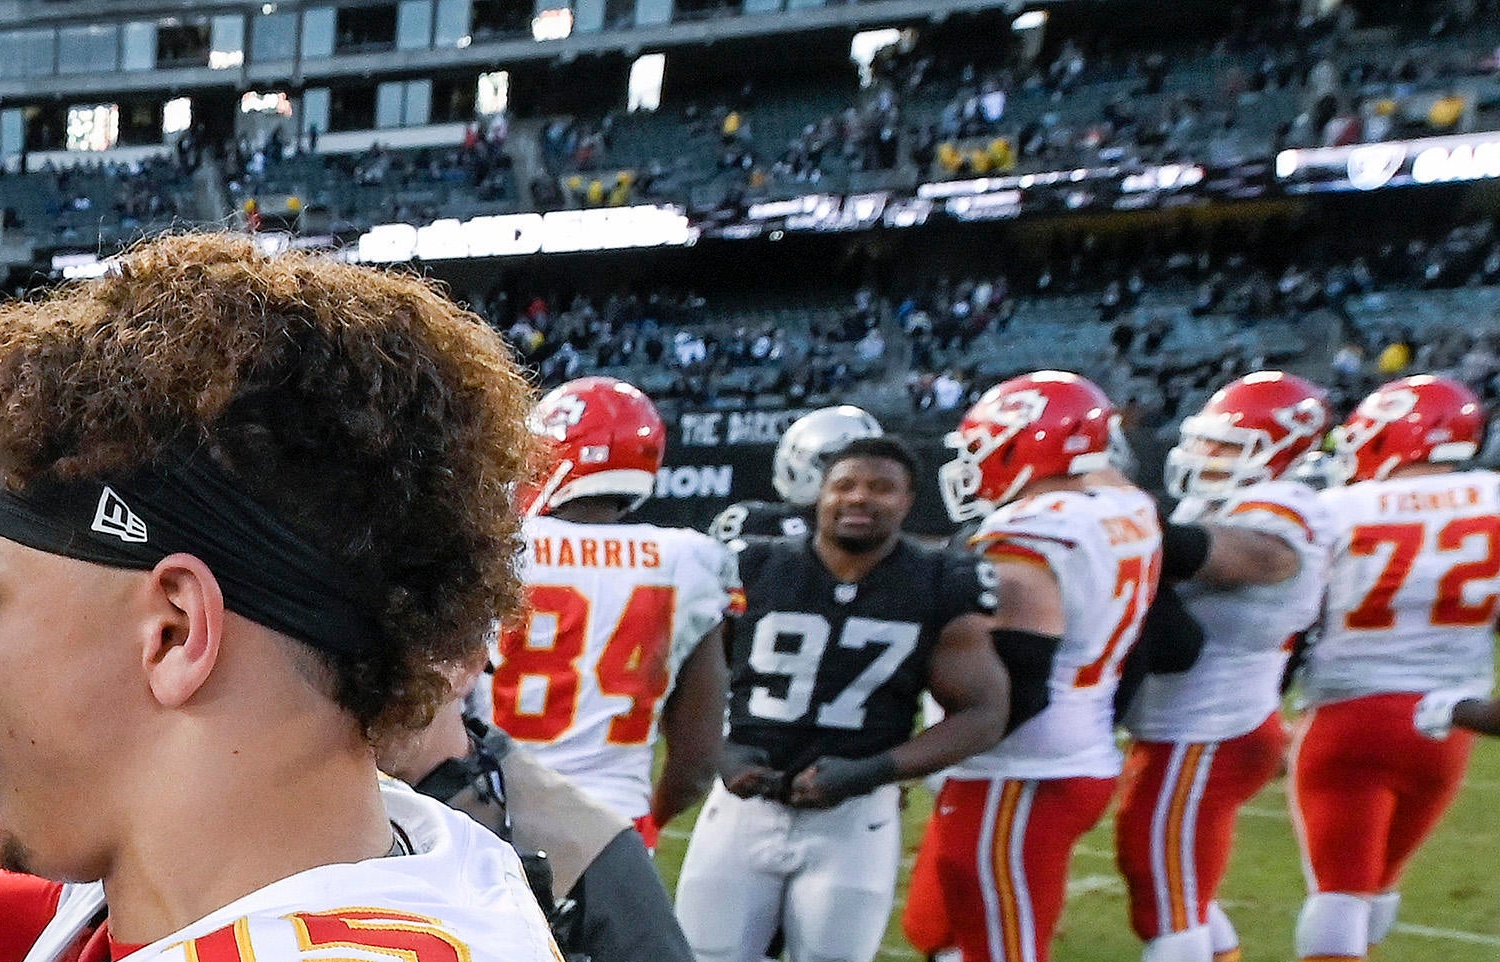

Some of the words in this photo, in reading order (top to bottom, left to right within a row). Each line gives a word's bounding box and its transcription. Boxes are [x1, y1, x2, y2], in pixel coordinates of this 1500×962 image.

[534, 538, 660, 568] HARRIS
[1345, 515, 1500, 631] 72
[492, 583, 678, 745] 84
[748, 612, 921, 729] 97
